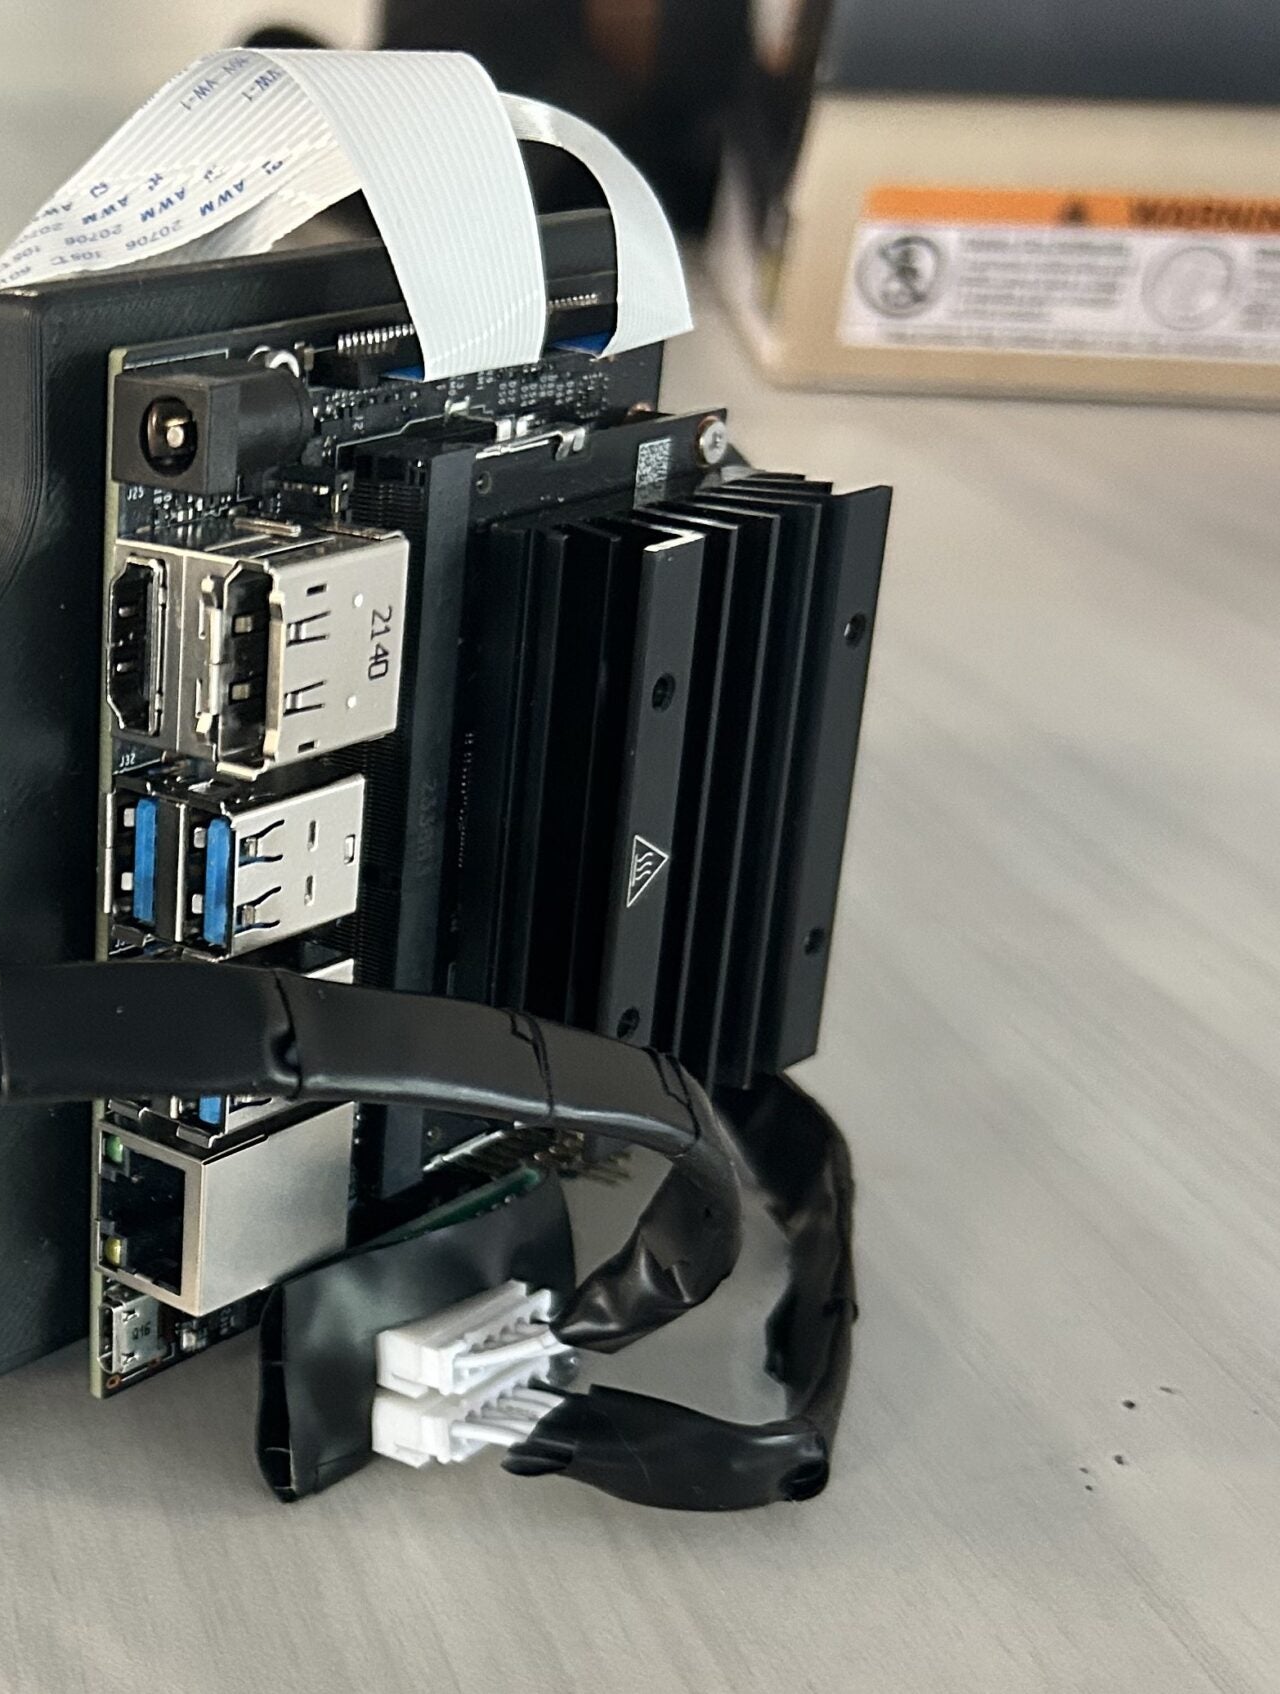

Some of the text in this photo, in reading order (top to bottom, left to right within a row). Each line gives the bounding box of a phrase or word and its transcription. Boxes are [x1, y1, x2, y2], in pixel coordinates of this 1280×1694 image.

[82, 194, 129, 225] AWM
[140, 187, 186, 222] AWM
[199, 179, 245, 217] AWM
[125, 219, 183, 250] 20706
[368, 605, 393, 681] 2140
[119, 752, 136, 767] J32
